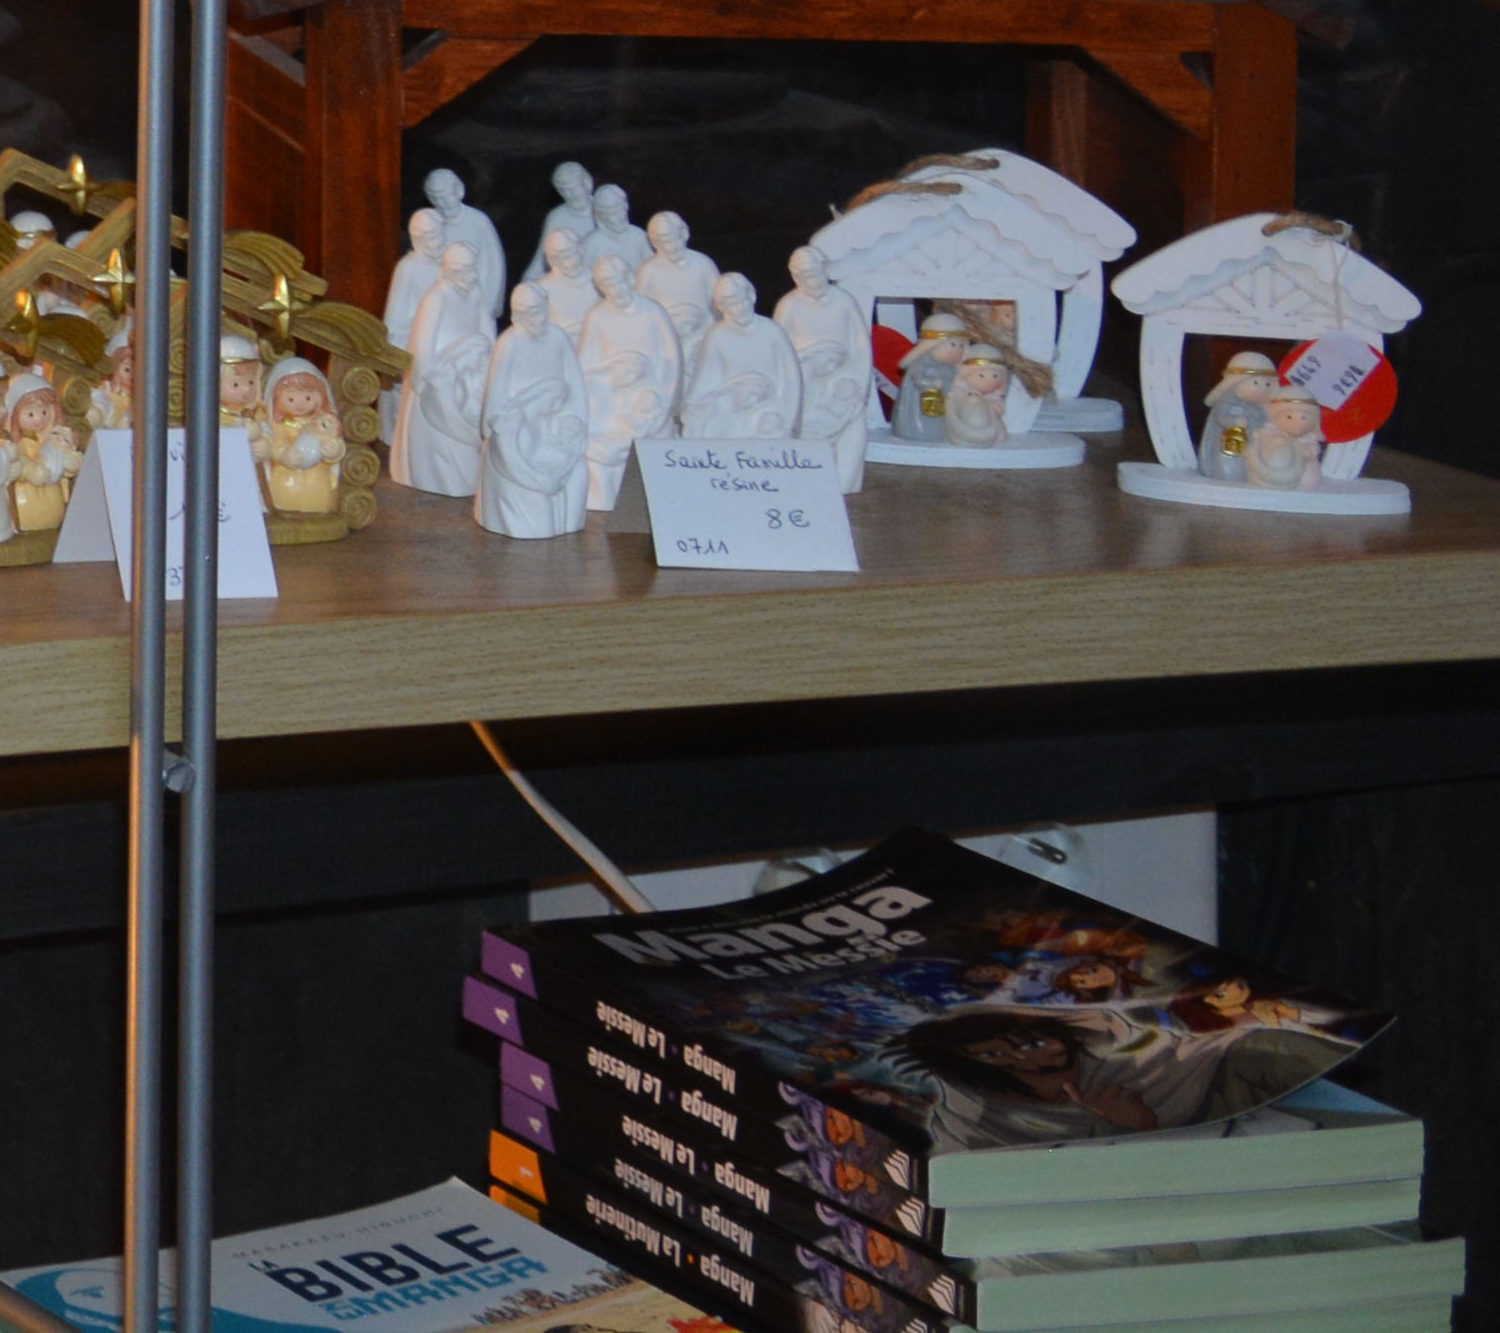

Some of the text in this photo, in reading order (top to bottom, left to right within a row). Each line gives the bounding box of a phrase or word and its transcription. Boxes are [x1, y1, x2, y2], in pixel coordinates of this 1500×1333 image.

[664, 448, 824, 471] Sainte Famille
[710, 473, 780, 493] résine
[676, 539, 730, 555] 0711
[593, 885, 934, 967] Manga
[700, 929, 928, 981] Le Messie
[596, 1000, 646, 1048] Messie
[647, 1026, 666, 1058] Le
[587, 1046, 641, 1094] Messie
[642, 1079, 662, 1105] Le
[683, 1044, 736, 1095] Manga
[622, 1114, 674, 1164] Messie
[680, 1090, 738, 1141] Manga
[614, 1157, 663, 1207] Messie
[676, 1142, 695, 1175] Le
[665, 1187, 683, 1218] Le
[714, 1162, 770, 1214] Manga
[585, 1194, 754, 1306] Manga La Mutinerie
[701, 1205, 754, 1257] Manga
[249, 1259, 279, 1272] LA
[265, 1224, 522, 1303] BIBLE
[347, 1256, 549, 1313] MANGA
